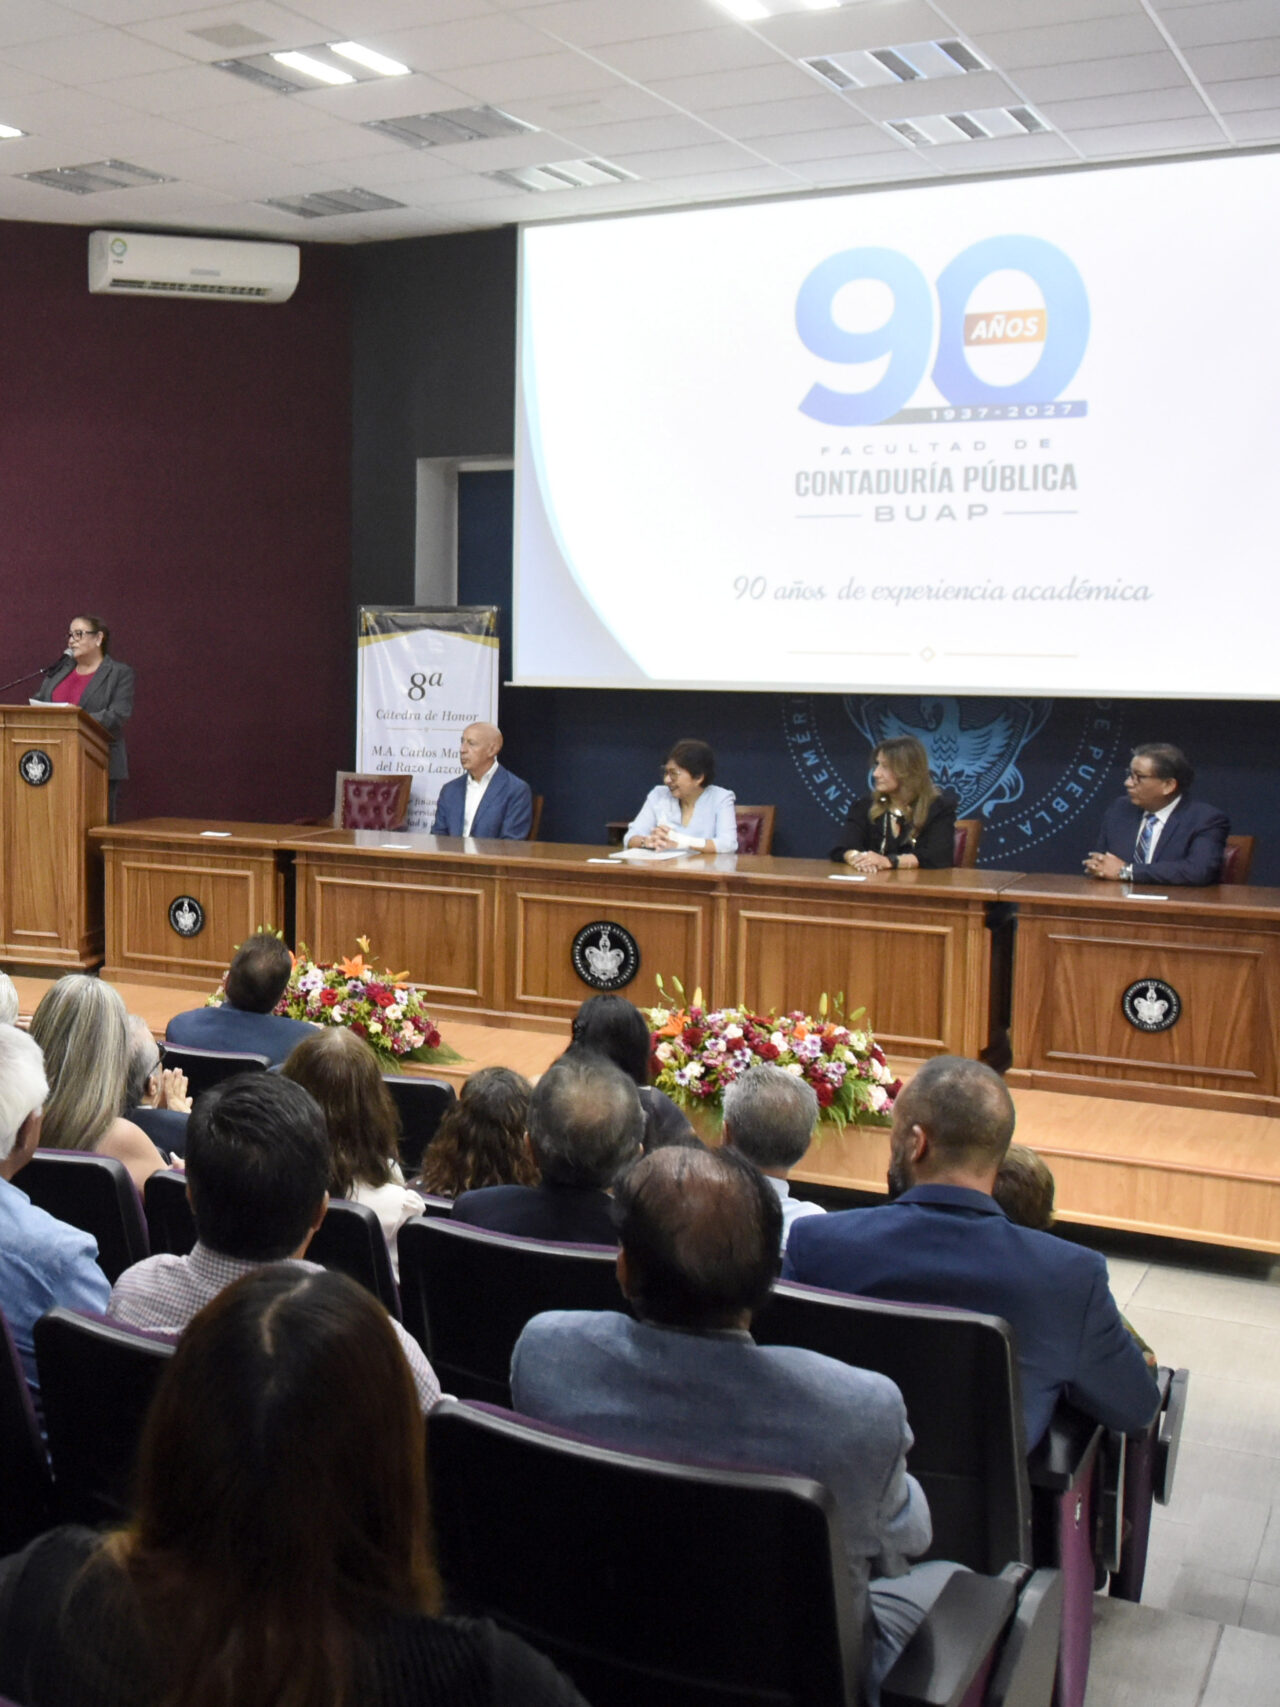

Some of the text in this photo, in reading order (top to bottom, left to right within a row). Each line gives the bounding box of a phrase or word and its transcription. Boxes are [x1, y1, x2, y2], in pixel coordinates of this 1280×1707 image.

[795, 233, 1091, 427] 90
[970, 314, 1039, 341] AÑOS
[931, 403, 1072, 421] 1937-2027
[821, 438, 1051, 456] FACULTAD DE
[795, 459, 1078, 498] CONTADURÍA PÚBLICA
[874, 503, 989, 523] BUAP
[732, 575, 1154, 607] 90 años de experiencia académica
[376, 708, 479, 722] Cátedra de Honor
[400, 746, 437, 759] Carlos
[376, 760, 392, 772] del
[396, 761, 425, 774] Razo
[1016, 745, 1104, 836] PUEBLA
